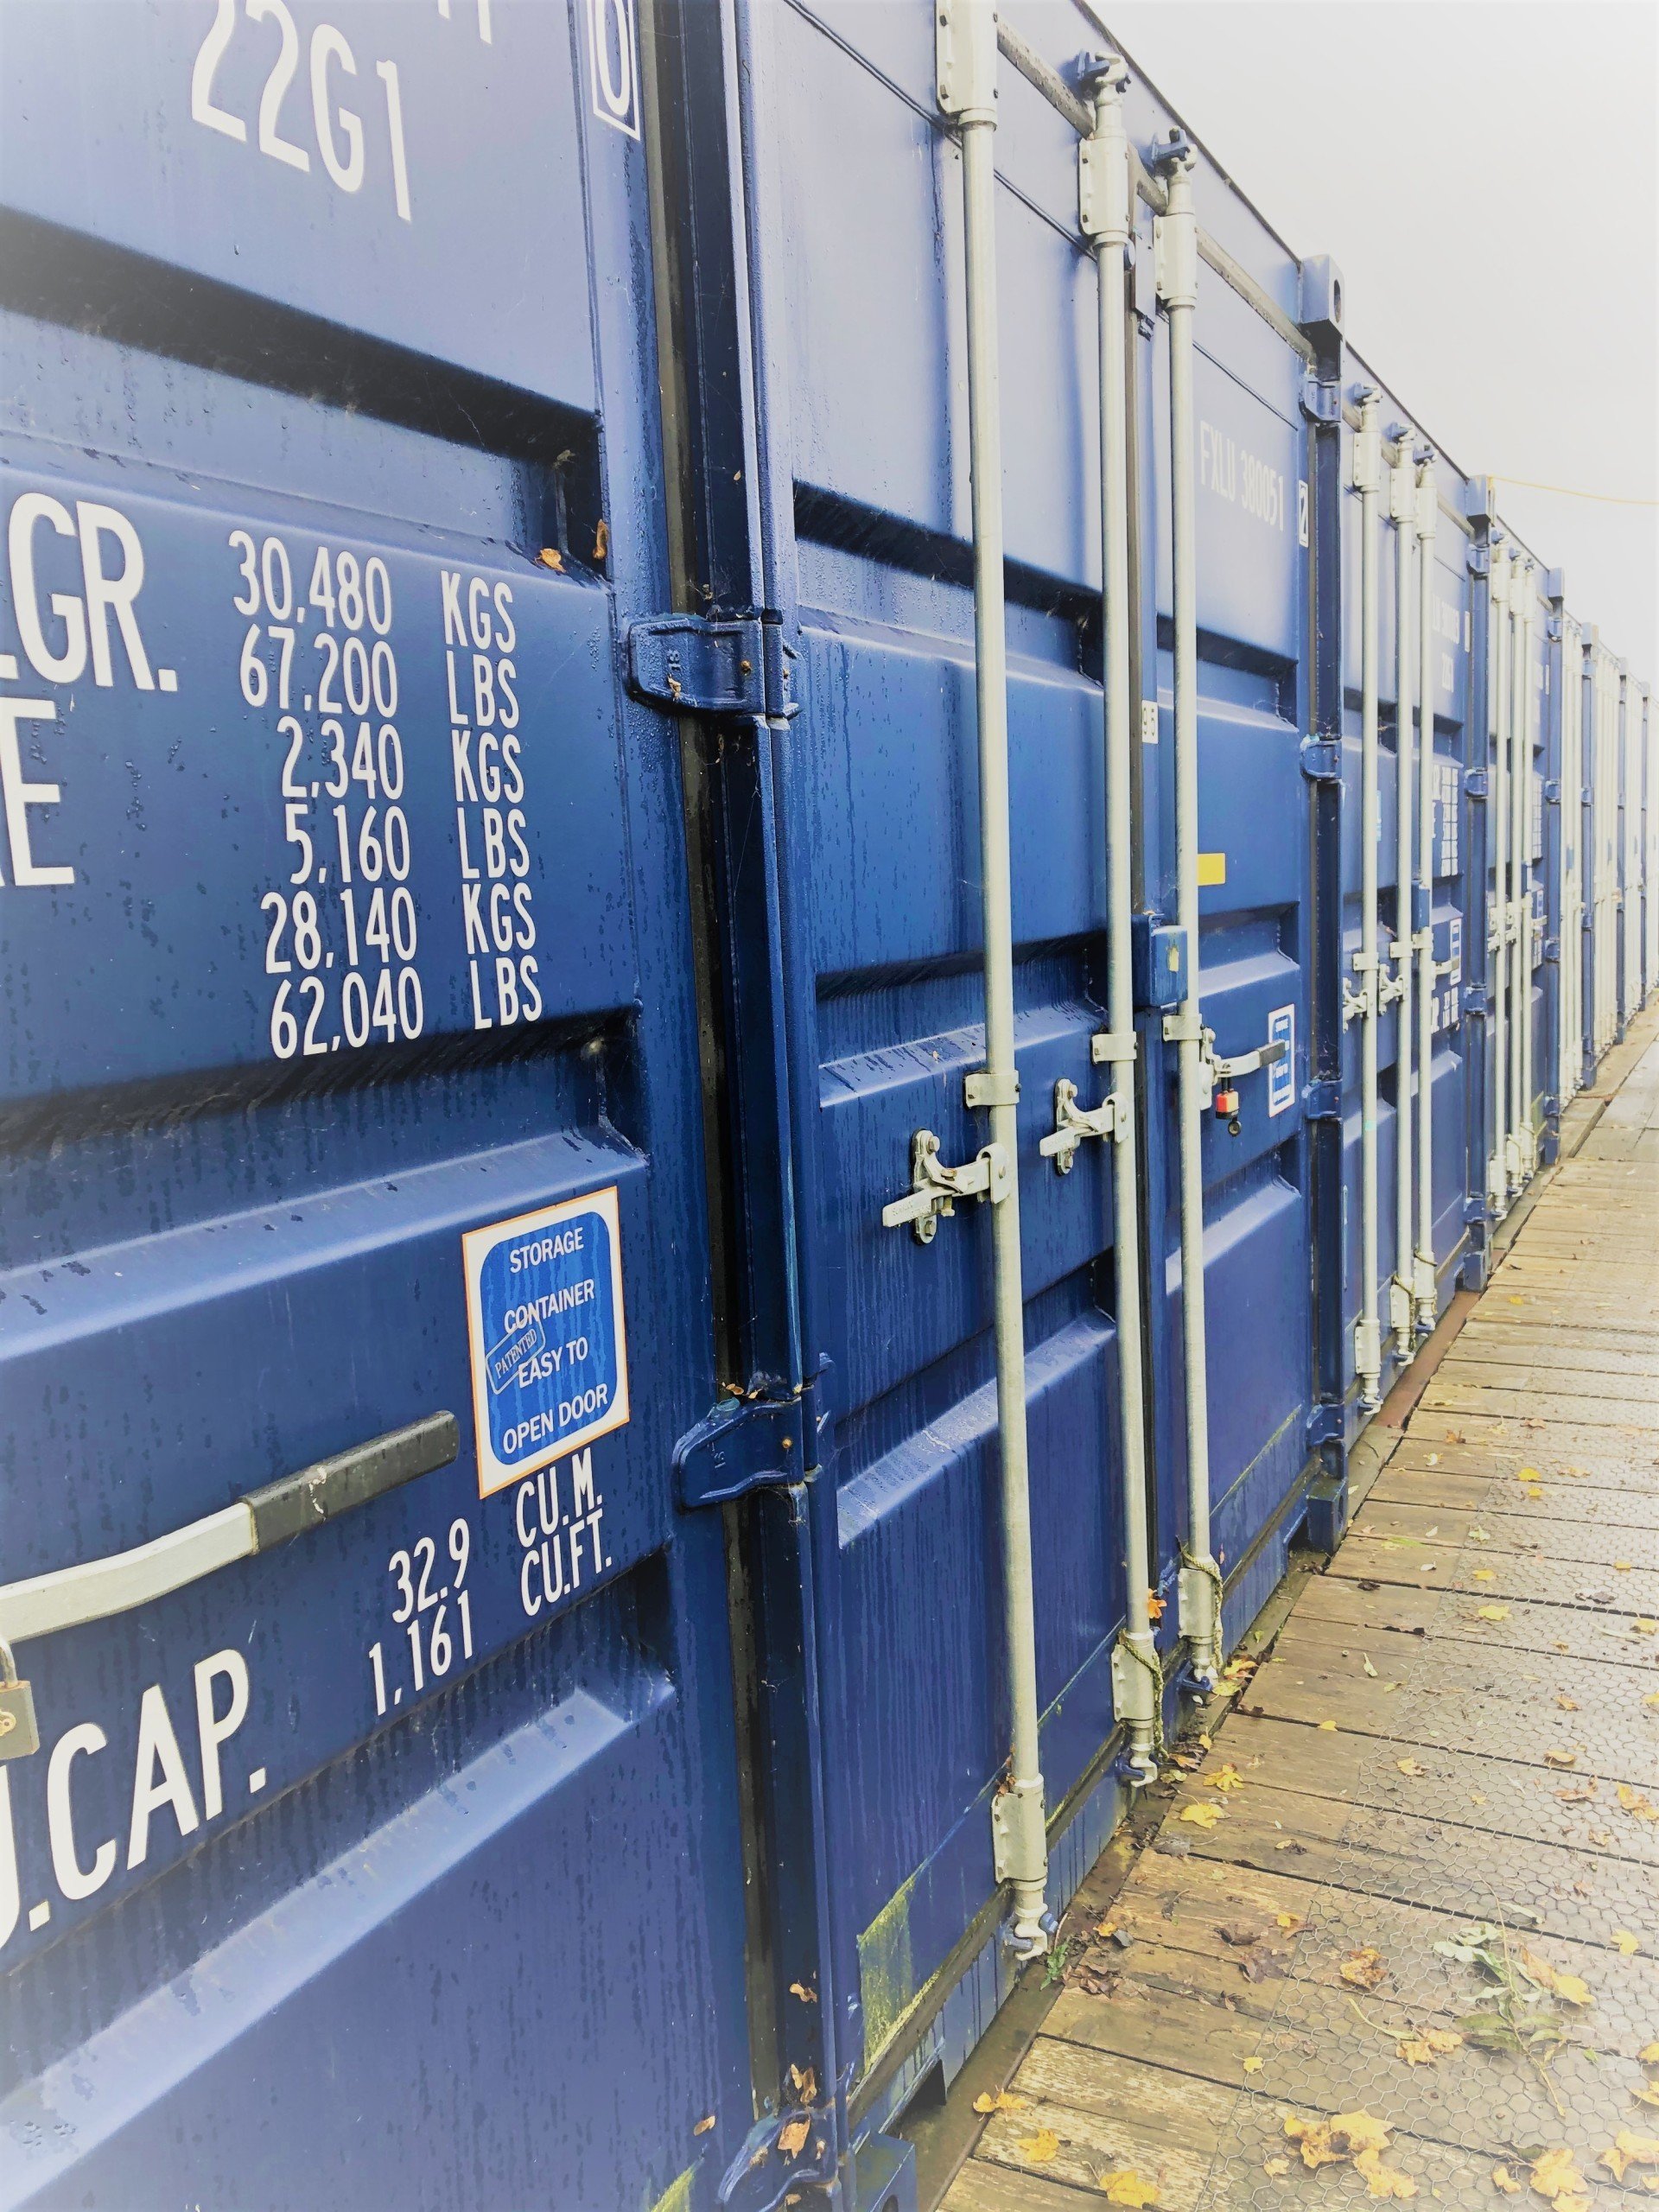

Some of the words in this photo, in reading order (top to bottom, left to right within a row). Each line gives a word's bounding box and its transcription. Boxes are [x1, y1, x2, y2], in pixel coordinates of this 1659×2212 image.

[191, 0, 410, 222] 22G1
[1200, 420, 1235, 502] FXLU
[1241, 449, 1283, 531] 380051
[228, 530, 392, 635] 30,480
[441, 570, 517, 654] KGS
[240, 624, 397, 718] 67,200
[446, 651, 519, 729] LBS
[276, 715, 404, 800] 2,340
[451, 729, 524, 804] KGS
[284, 803, 410, 885] 5,160
[456, 807, 531, 880] LBS
[260, 887, 417, 975] 28,140
[461, 882, 537, 955] KGS
[270, 966, 424, 1059] 62,040
[469, 955, 543, 1030] LBS
[509, 1227, 584, 1274] STORAGE
[504, 1278, 595, 1336] CONTAINER
[493, 1328, 537, 1381] PATENTED
[518, 1349, 563, 1389] EASY
[566, 1336, 589, 1365] TO
[503, 1408, 555, 1455] OPEN
[558, 1382, 608, 1421] DOOR
[388, 1517, 470, 1624] 32.9
[516, 1446, 603, 1548] CU.M.
[521, 1508, 613, 1618] CU.FT.
